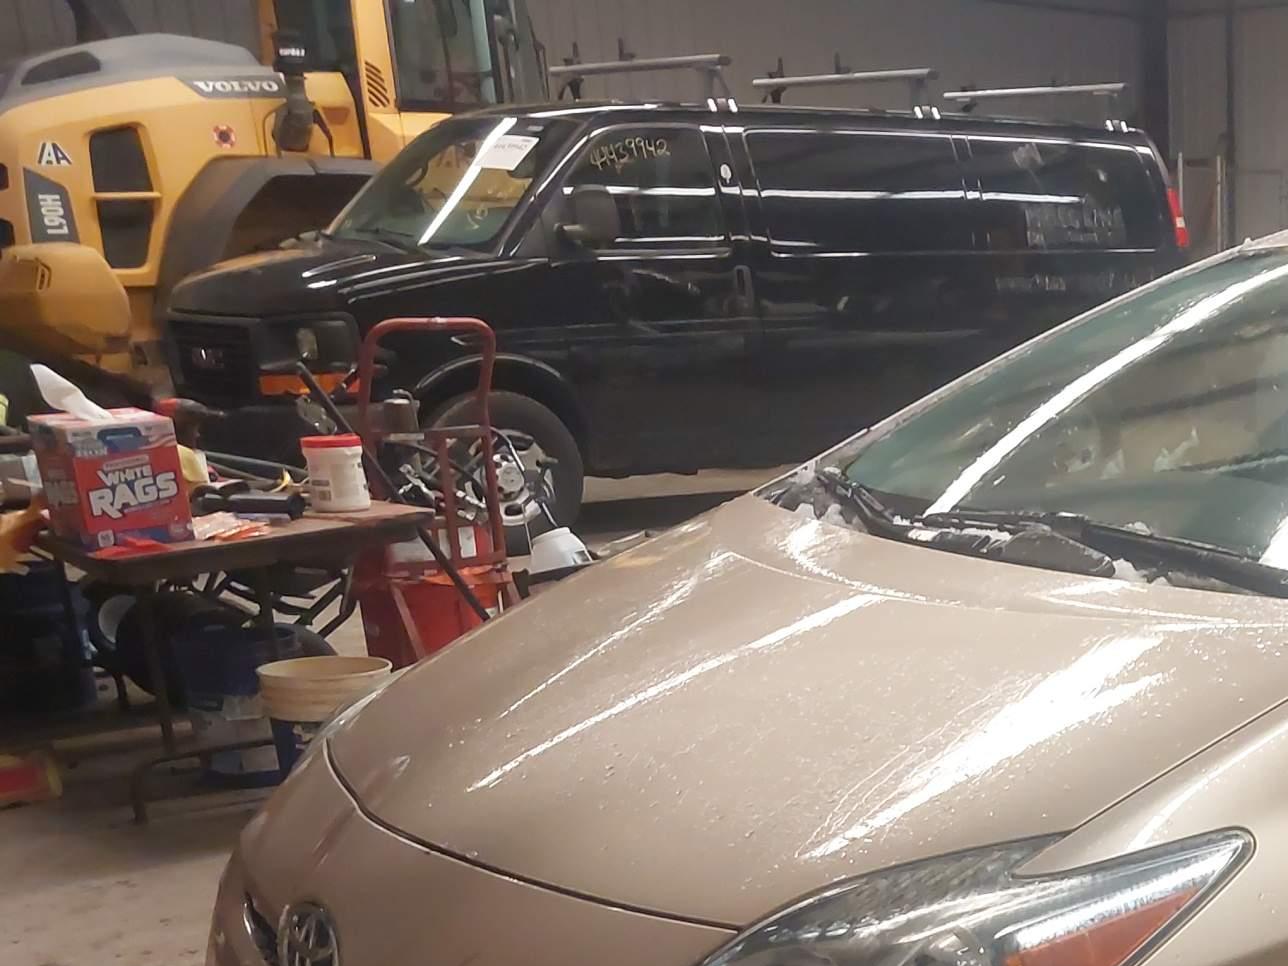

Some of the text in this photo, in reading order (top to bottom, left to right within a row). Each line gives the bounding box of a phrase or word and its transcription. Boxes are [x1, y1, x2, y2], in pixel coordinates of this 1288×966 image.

[193, 80, 279, 93] VOLVO
[38, 193, 69, 235] L90H
[96, 463, 153, 487] WHITE
[88, 471, 178, 519] RAGS
